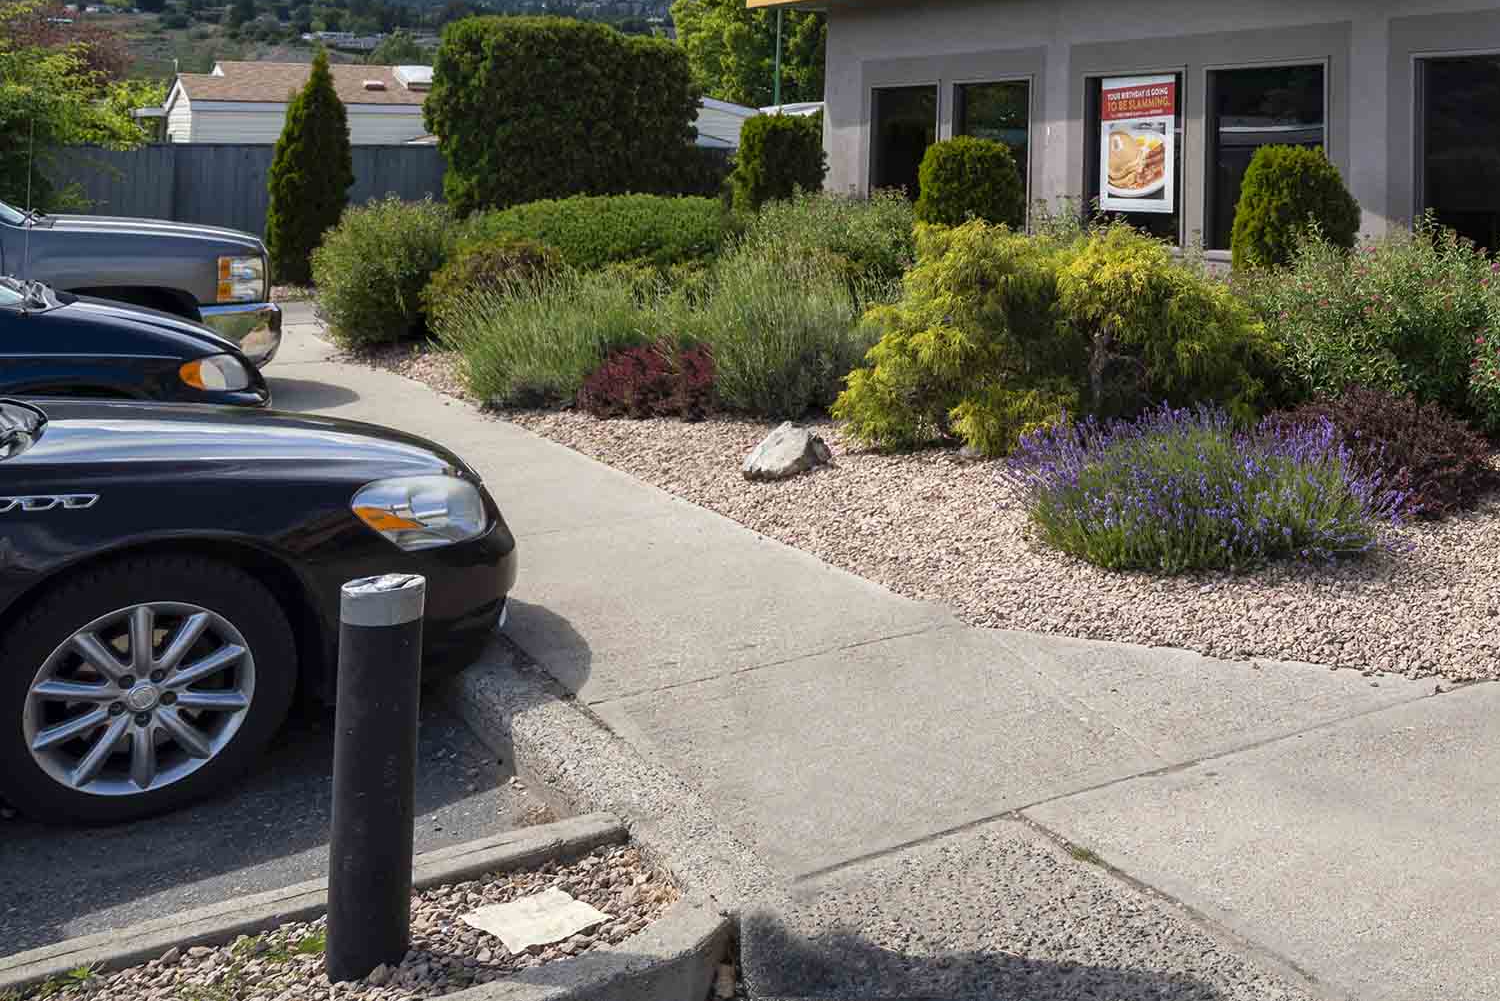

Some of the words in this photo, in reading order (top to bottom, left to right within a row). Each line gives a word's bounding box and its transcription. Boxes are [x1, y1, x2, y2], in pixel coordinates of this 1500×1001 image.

[1151, 87, 1168, 95] GOING
[1107, 101, 1118, 112] TO
[1119, 100, 1128, 111] BE
